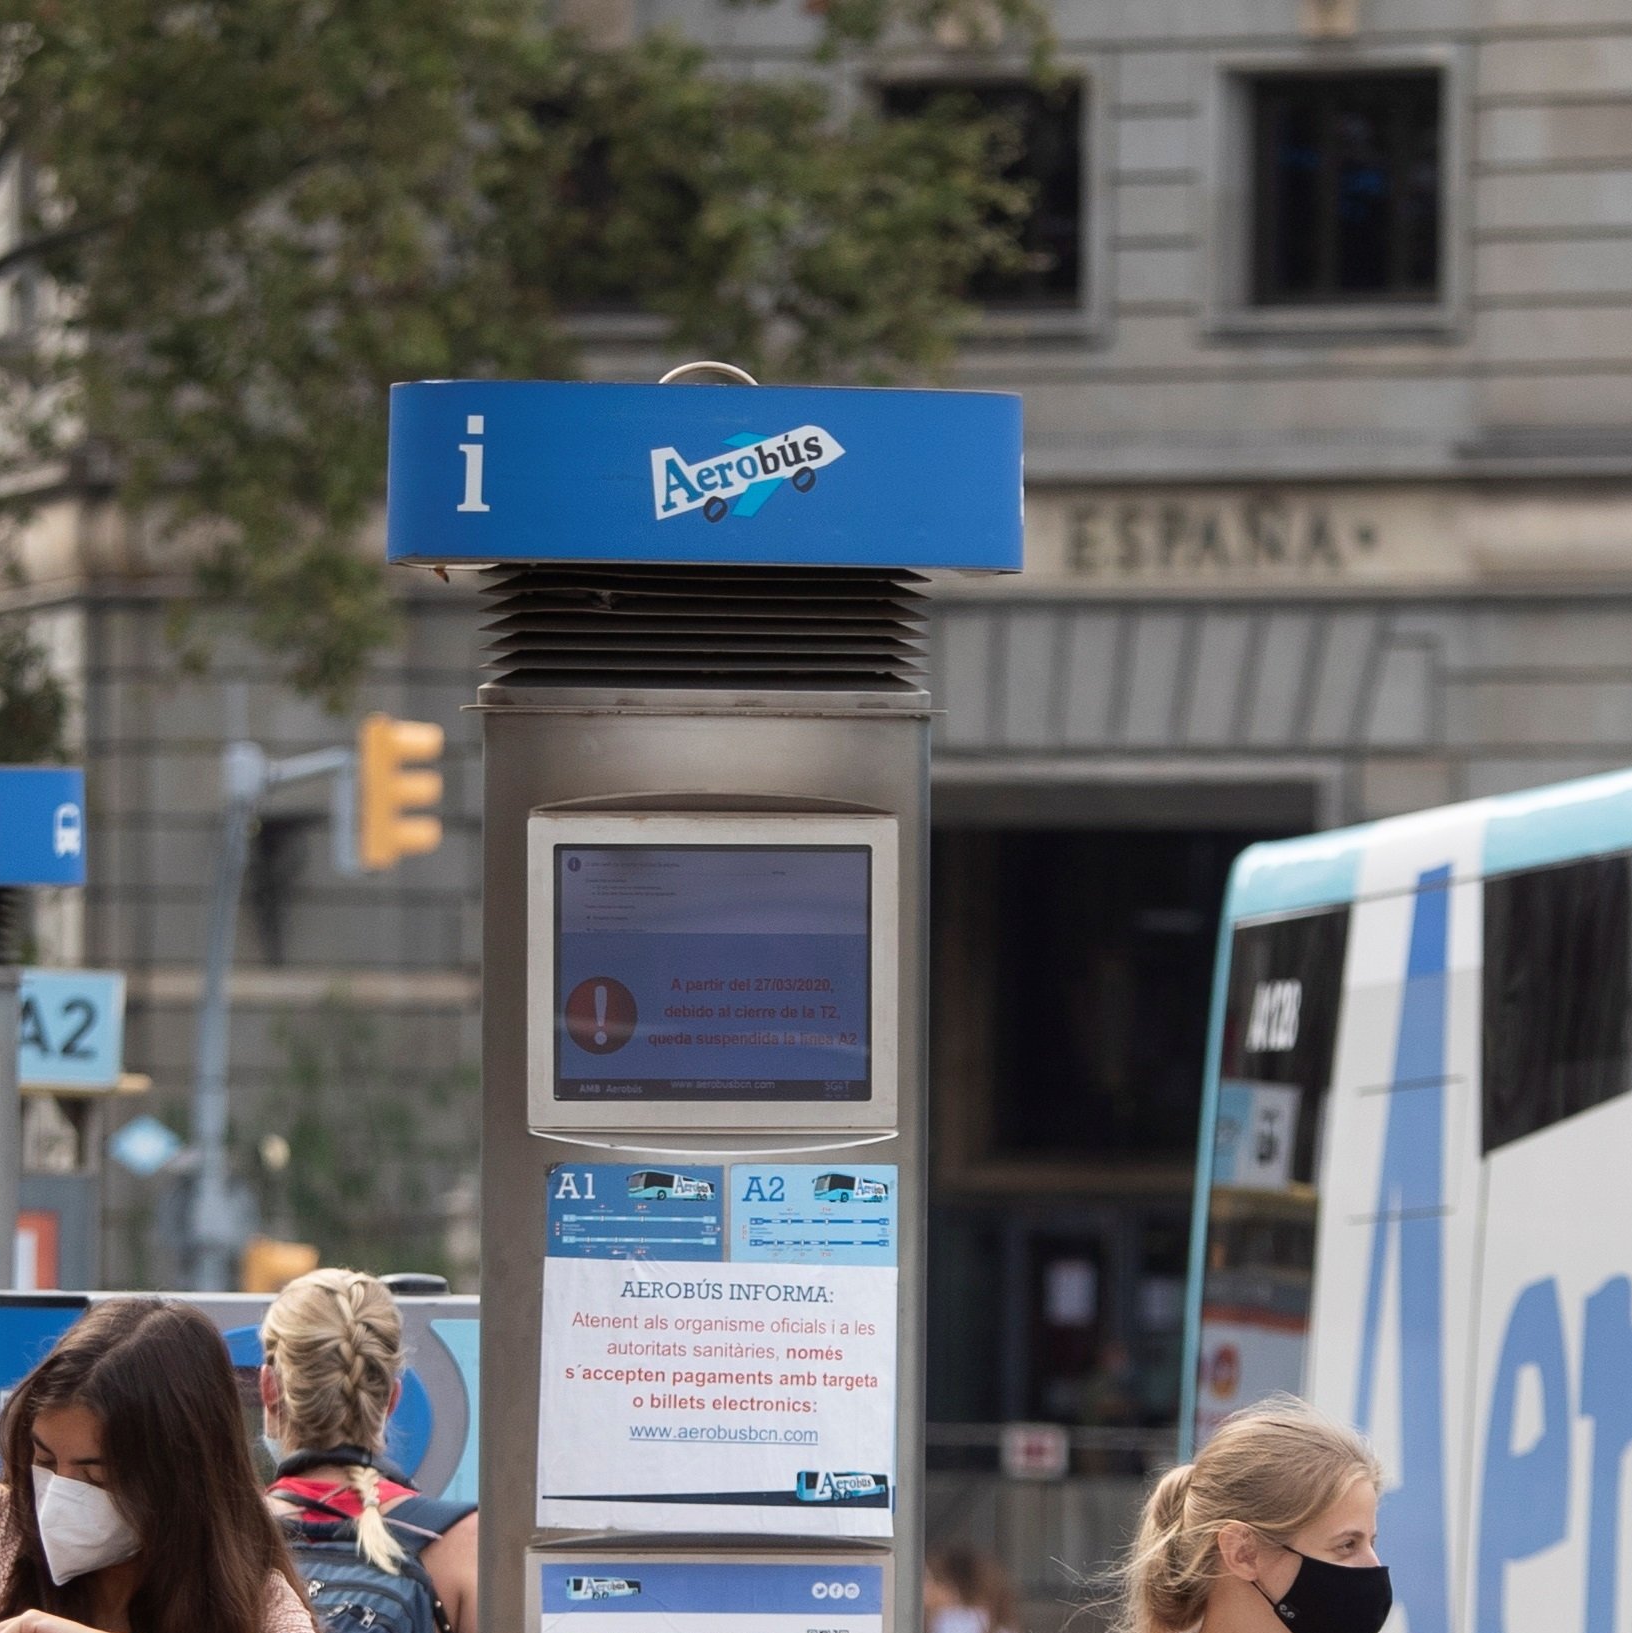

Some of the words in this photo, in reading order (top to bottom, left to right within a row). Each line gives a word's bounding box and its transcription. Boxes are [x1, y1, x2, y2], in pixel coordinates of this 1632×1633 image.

[661, 431, 823, 512] Aerobús
[670, 979, 681, 991] A
[686, 978, 723, 993] partir
[730, 978, 750, 991] del
[664, 1006, 713, 1019] debido
[719, 1006, 731, 1019] al
[734, 1006, 775, 1019] cierre
[780, 1006, 798, 1019] de
[803, 1006, 815, 1019] la
[820, 1006, 840, 1020] T2,
[22, 995, 97, 1060] A2
[648, 1034, 692, 1048] queda
[696, 1033, 778, 1046] suspendida
[783, 1034, 795, 1045] la
[838, 1033, 857, 1045] A2
[580, 1084, 600, 1094] AMB
[555, 1173, 596, 1200] A1
[742, 1176, 785, 1201] A2
[621, 1279, 723, 1301] AEROBÚS
[730, 1284, 834, 1303] INFORMA:
[572, 1311, 639, 1330] Atenent
[644, 1313, 668, 1330] als
[674, 1315, 765, 1334] organisme
[771, 1317, 826, 1334] oficials
[832, 1319, 836, 1334] i
[841, 1323, 849, 1335] a
[854, 1320, 875, 1336] les
[607, 1340, 687, 1357] autoritats
[693, 1342, 780, 1361] sanitàries,
[786, 1344, 843, 1361] només
[672, 1368, 773, 1387] pagaments
[779, 1369, 817, 1386] amb
[822, 1371, 878, 1391] targeta
[633, 1398, 643, 1409] o
[650, 1394, 706, 1410] billets
[712, 1395, 817, 1413] electronics:
[629, 1424, 819, 1443] www.aerobusbcn.com
